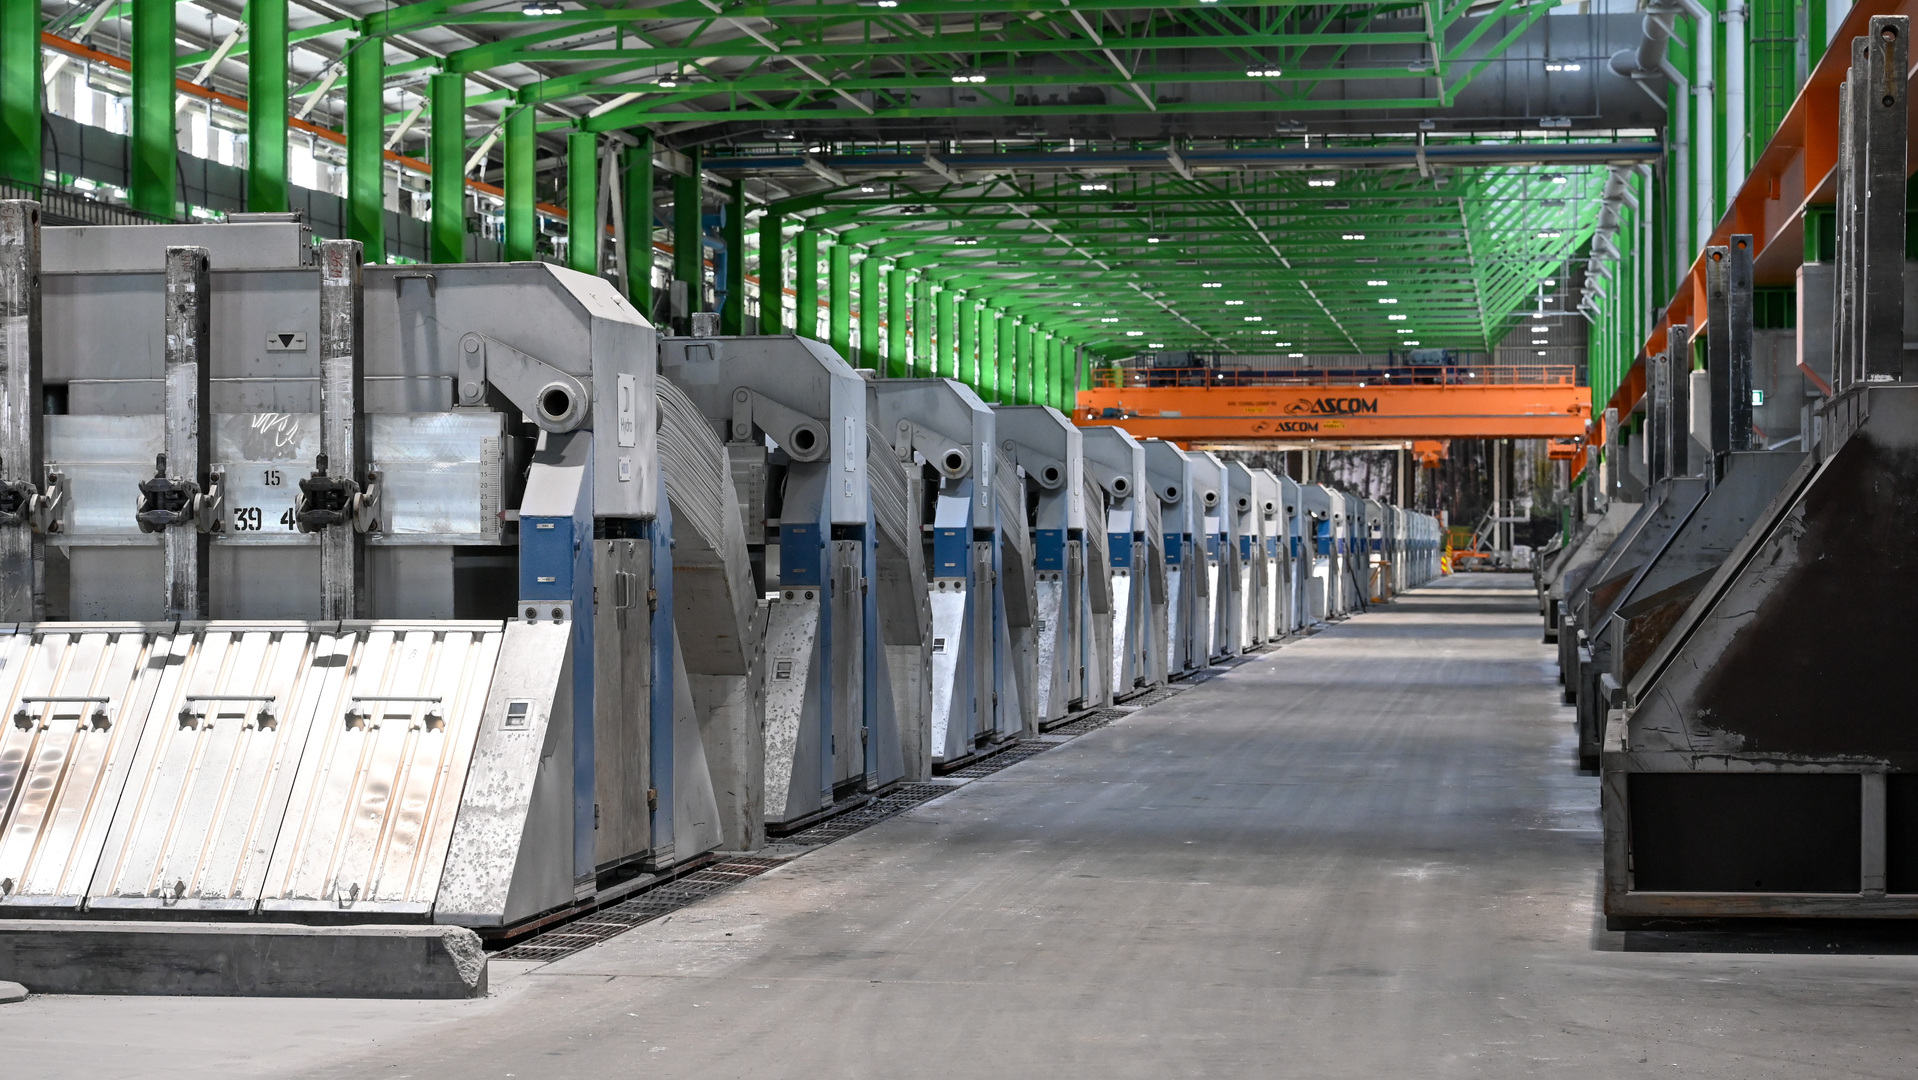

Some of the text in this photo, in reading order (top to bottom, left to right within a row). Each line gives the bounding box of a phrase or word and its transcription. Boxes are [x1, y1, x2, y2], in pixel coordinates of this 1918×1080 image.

[1310, 397, 1378, 416] ASCOM
[1274, 422, 1319, 432] ASCOM
[264, 470, 281, 486] 15
[233, 507, 262, 531] 39
